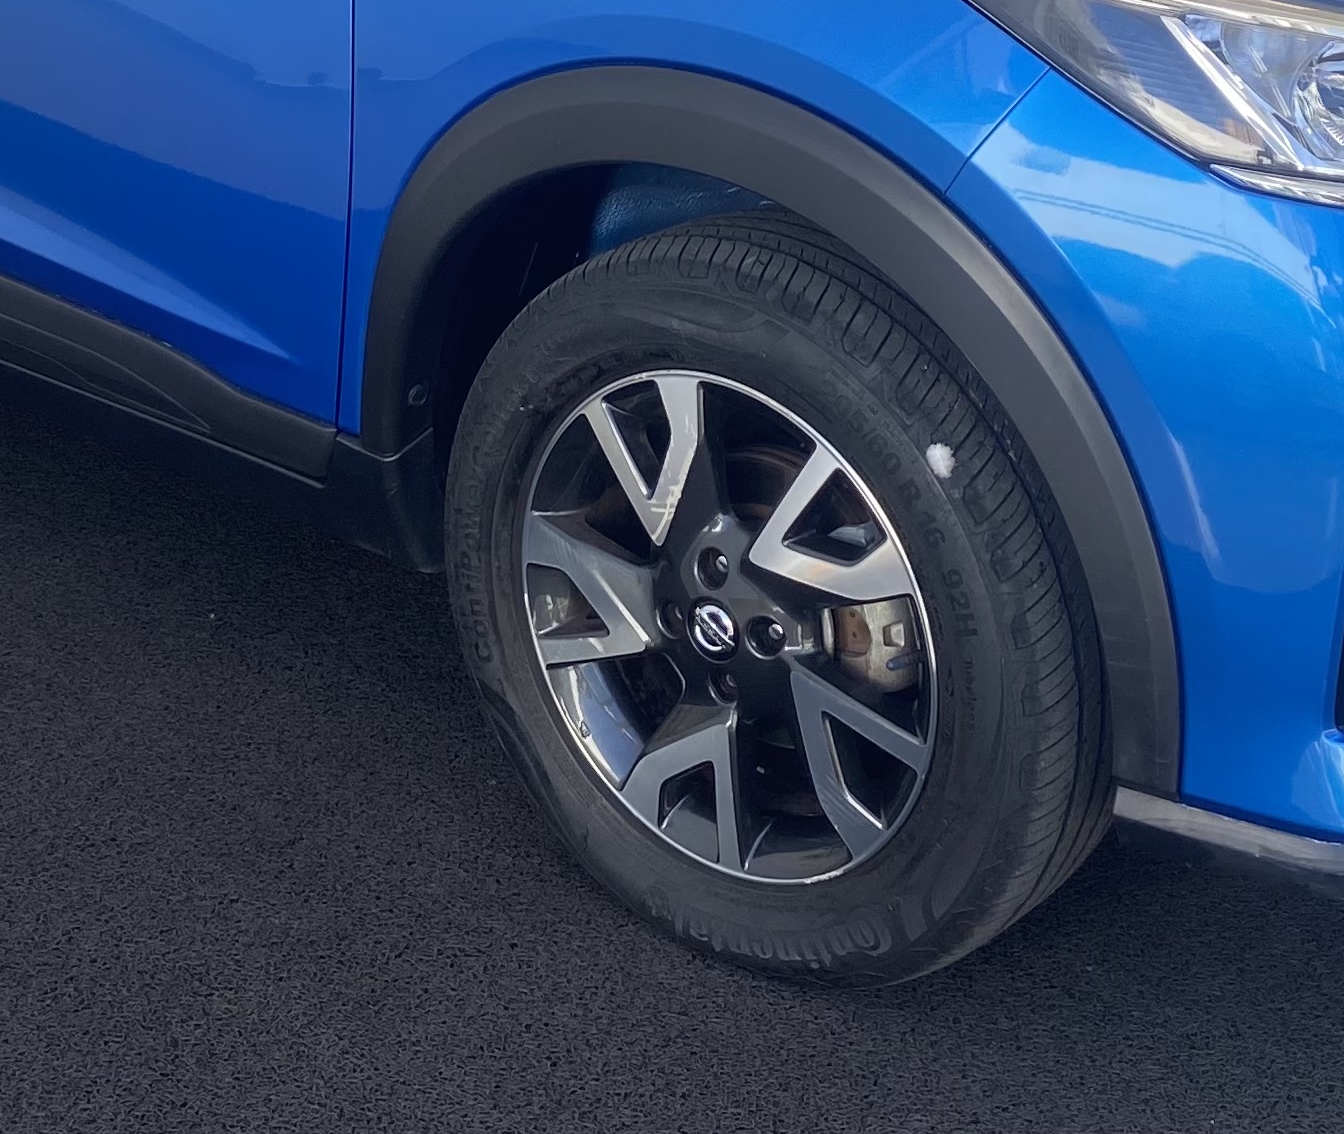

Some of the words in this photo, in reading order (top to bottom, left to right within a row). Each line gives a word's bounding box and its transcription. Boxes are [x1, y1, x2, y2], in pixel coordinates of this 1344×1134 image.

[819, 377, 902, 476] 205/60
[898, 477, 924, 511] R
[917, 510, 946, 549] 16
[940, 567, 979, 638] 92H
